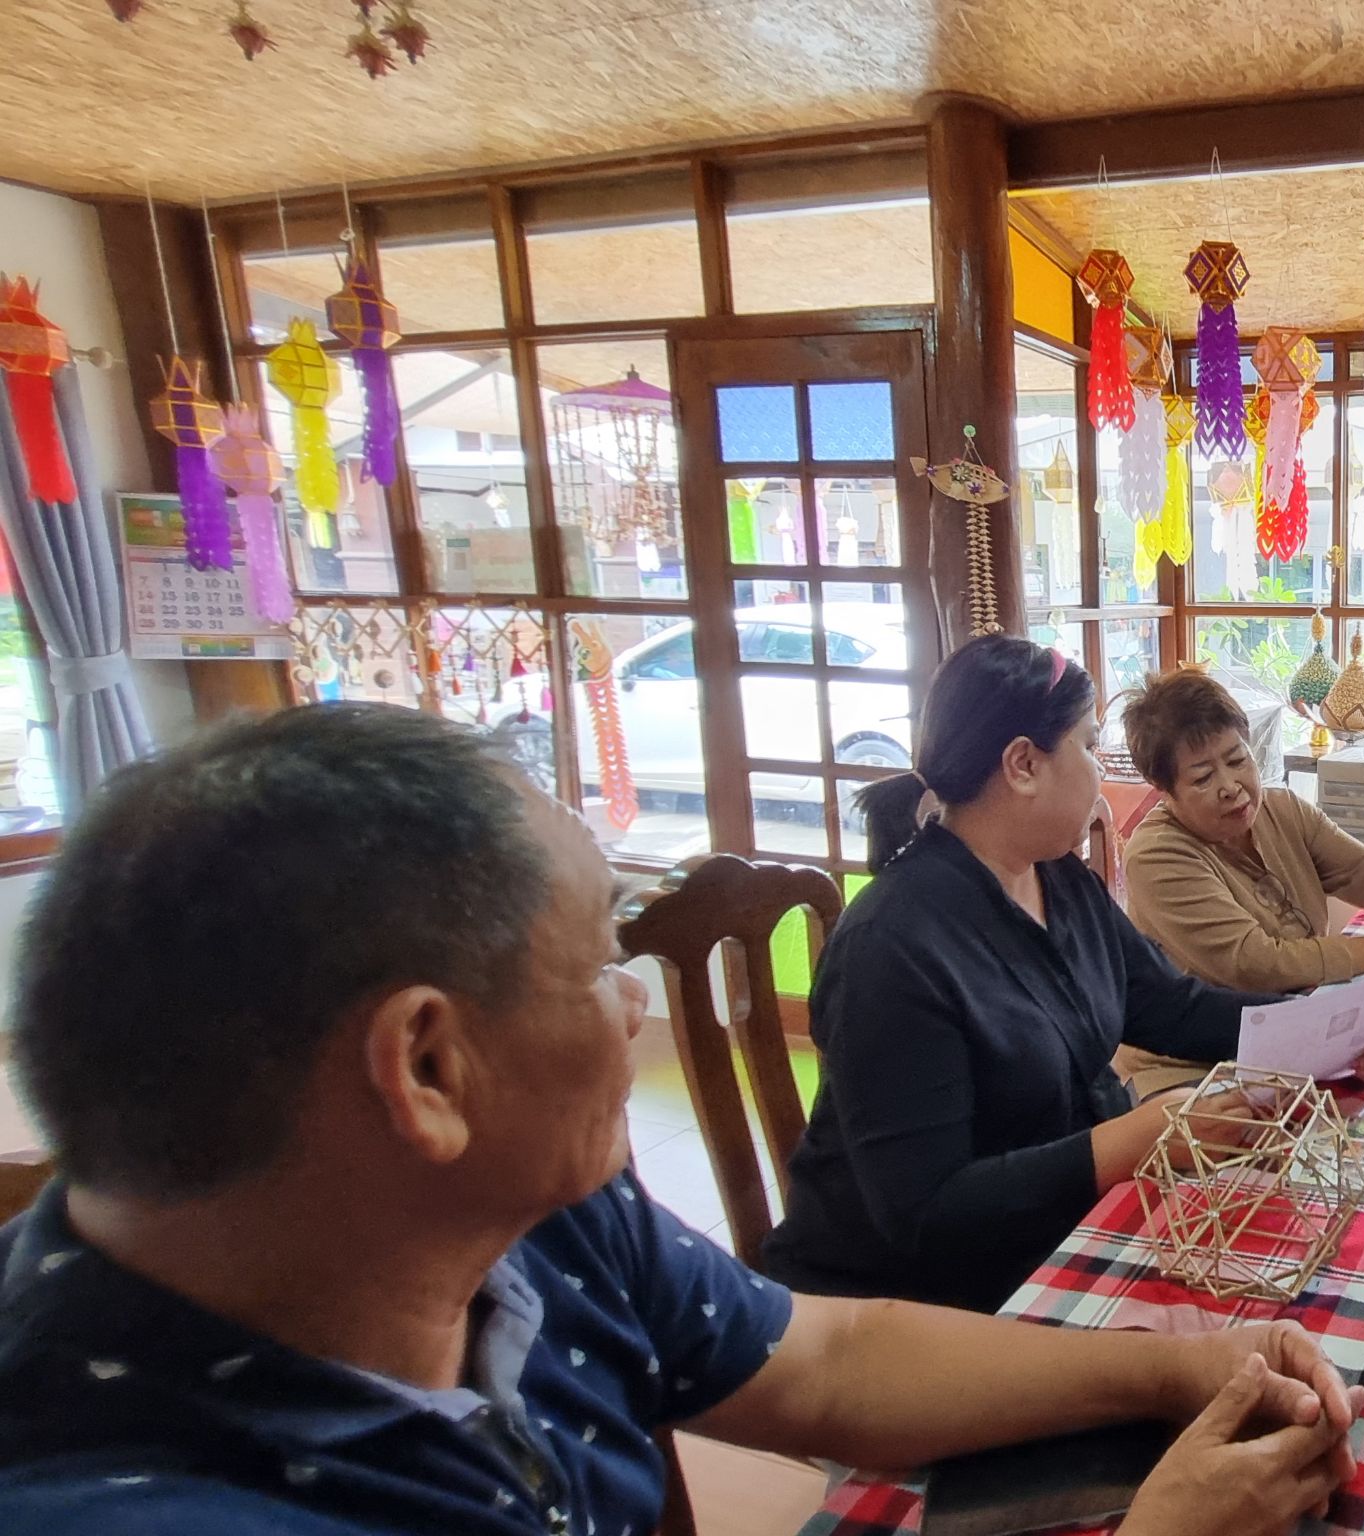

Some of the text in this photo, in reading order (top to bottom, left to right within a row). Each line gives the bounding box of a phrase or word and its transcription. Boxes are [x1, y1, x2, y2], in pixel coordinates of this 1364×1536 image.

[162, 577, 172, 588] 8
[184, 577, 194, 588] 9
[205, 578, 221, 589] 10
[226, 579, 240, 589] 11
[206, 592, 221, 602] 17
[161, 604, 178, 615] 22
[184, 605, 201, 616] 23
[207, 606, 223, 616] 24
[228, 606, 245, 616] 25
[186, 619, 203, 629] 30
[208, 619, 224, 630] 31
